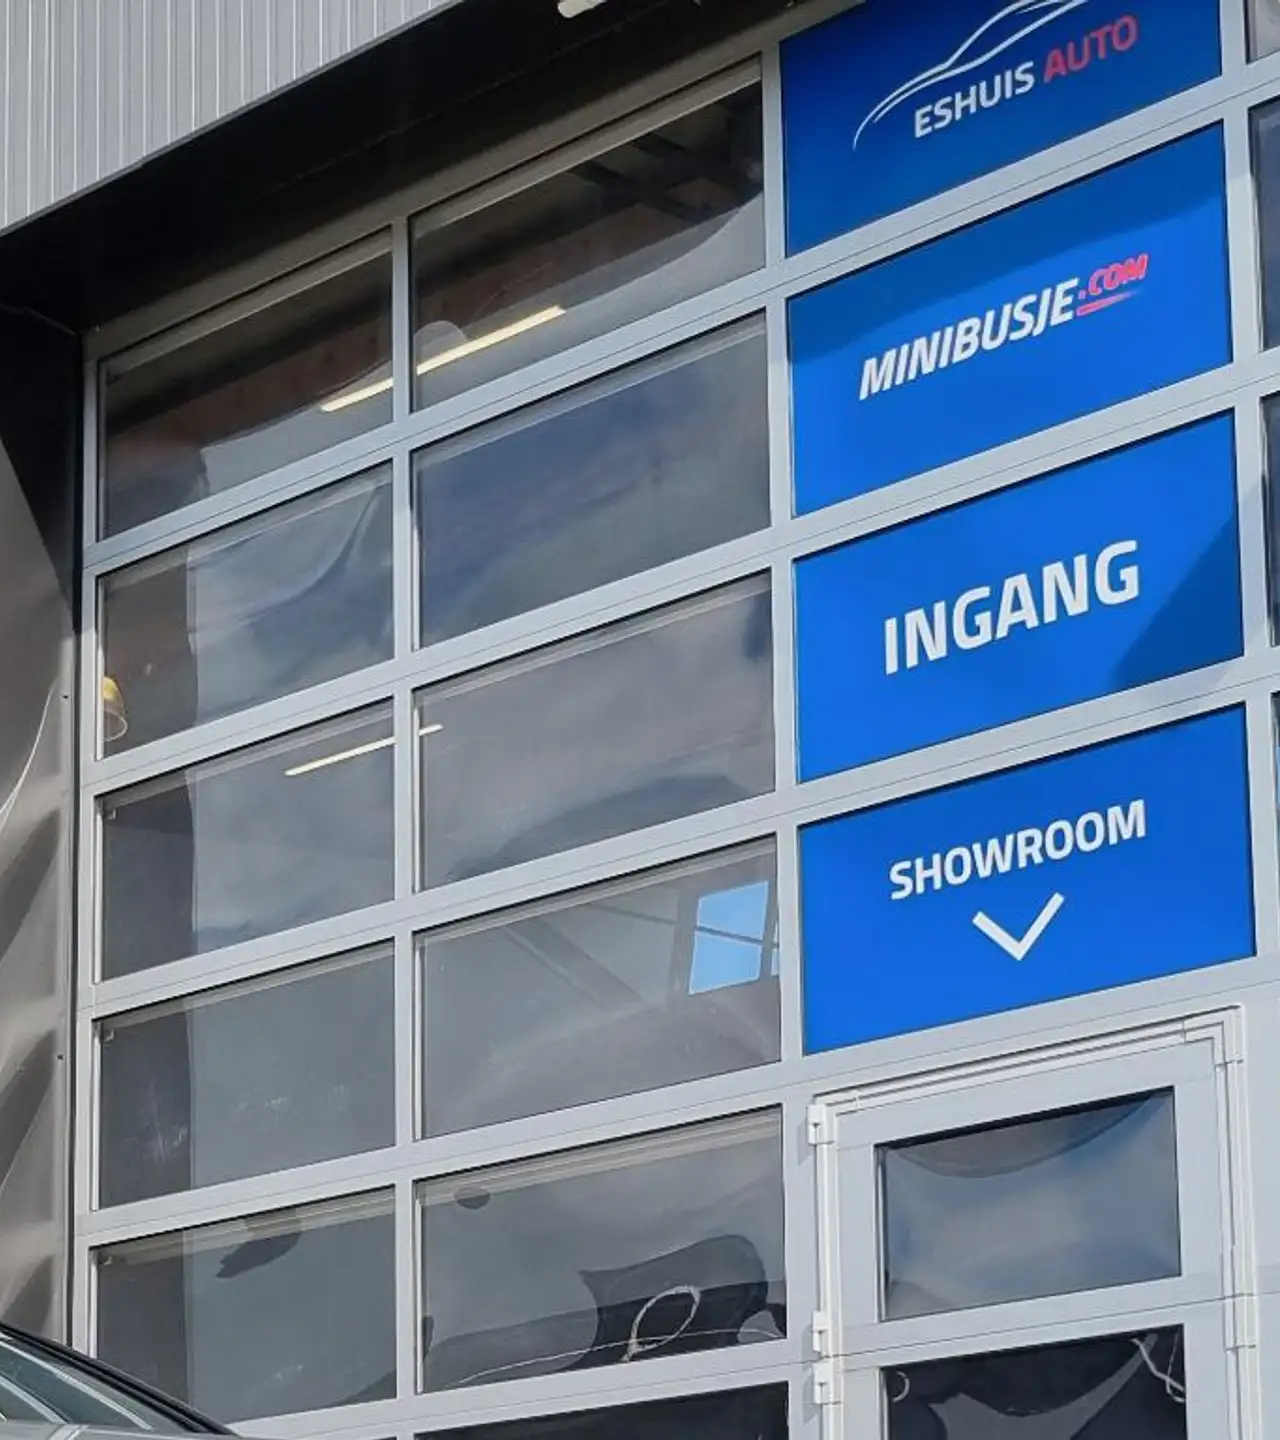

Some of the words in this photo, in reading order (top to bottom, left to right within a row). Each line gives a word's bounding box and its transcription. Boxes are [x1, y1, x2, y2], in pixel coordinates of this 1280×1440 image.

[914, 61, 1034, 137] ESHUIS
[1043, 15, 1138, 82] AUTO
[859, 253, 1149, 400] MINIBUSJE.COM
[884, 540, 1139, 676] INGANG
[889, 799, 1145, 900] SHOWROOM
